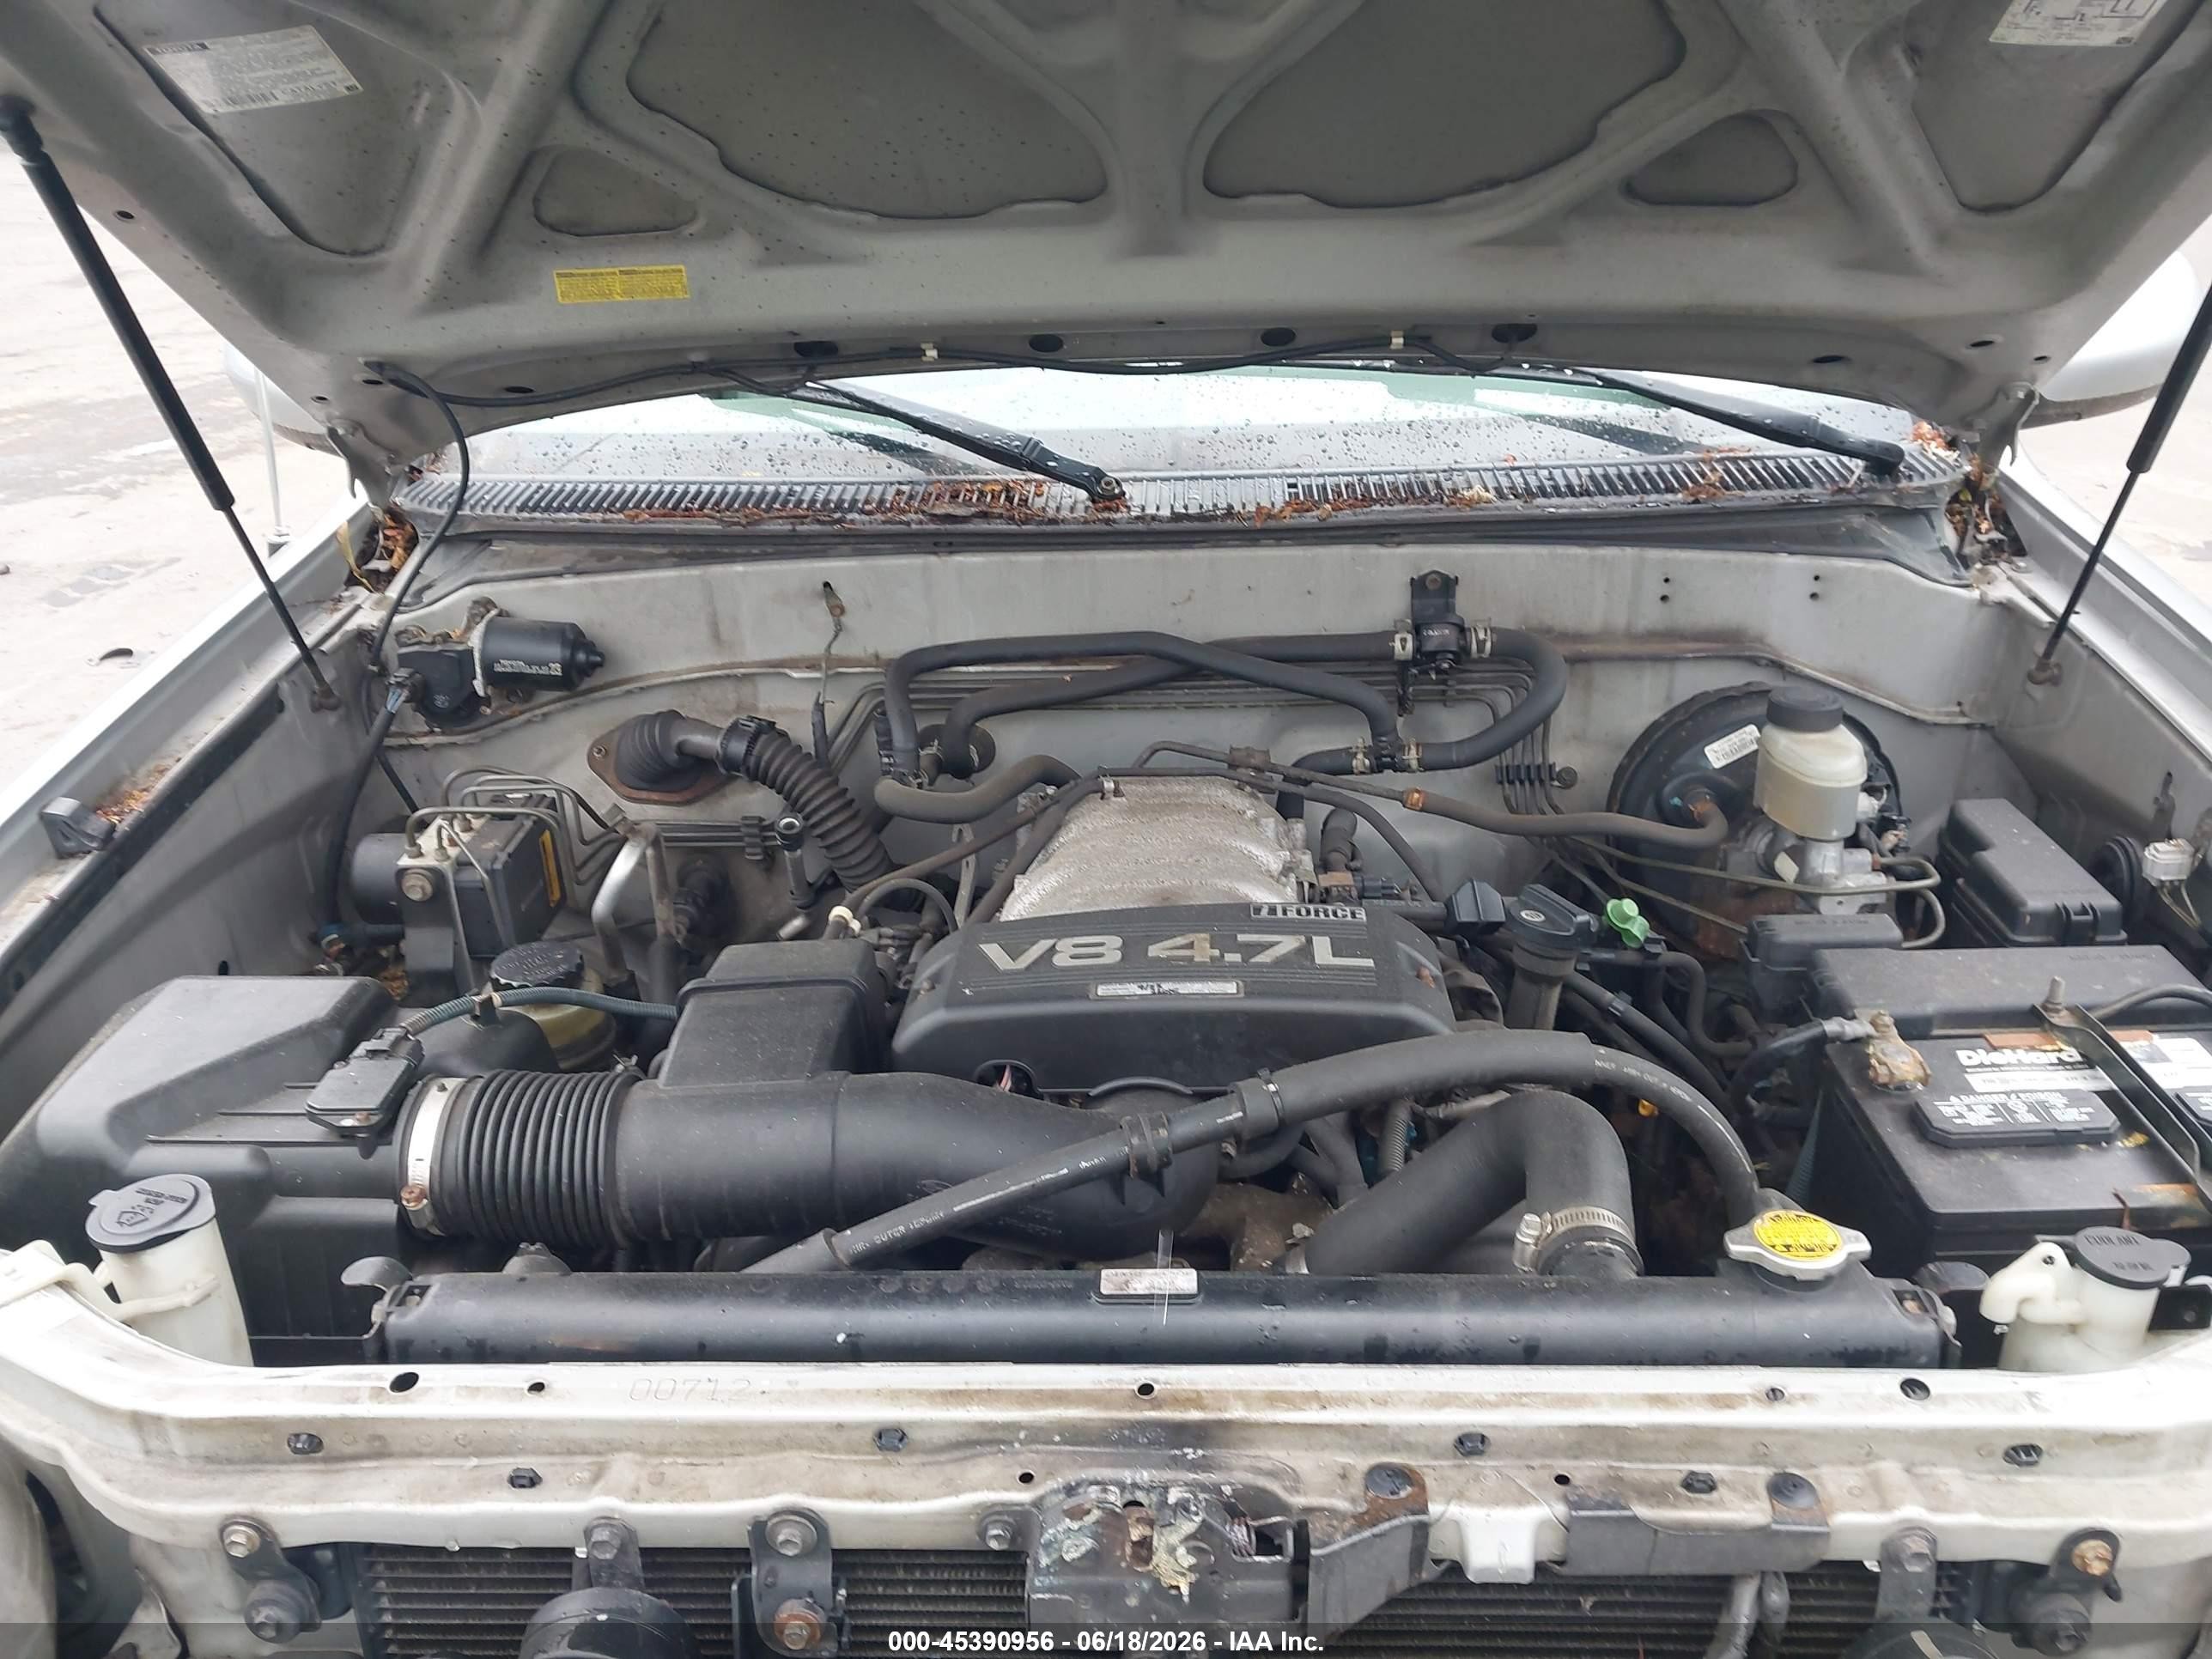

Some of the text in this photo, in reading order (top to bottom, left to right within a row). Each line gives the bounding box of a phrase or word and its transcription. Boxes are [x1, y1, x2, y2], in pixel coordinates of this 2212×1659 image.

[979, 933, 1374, 970] V8 4.7L
[1955, 1048, 2084, 1066] DieHard
